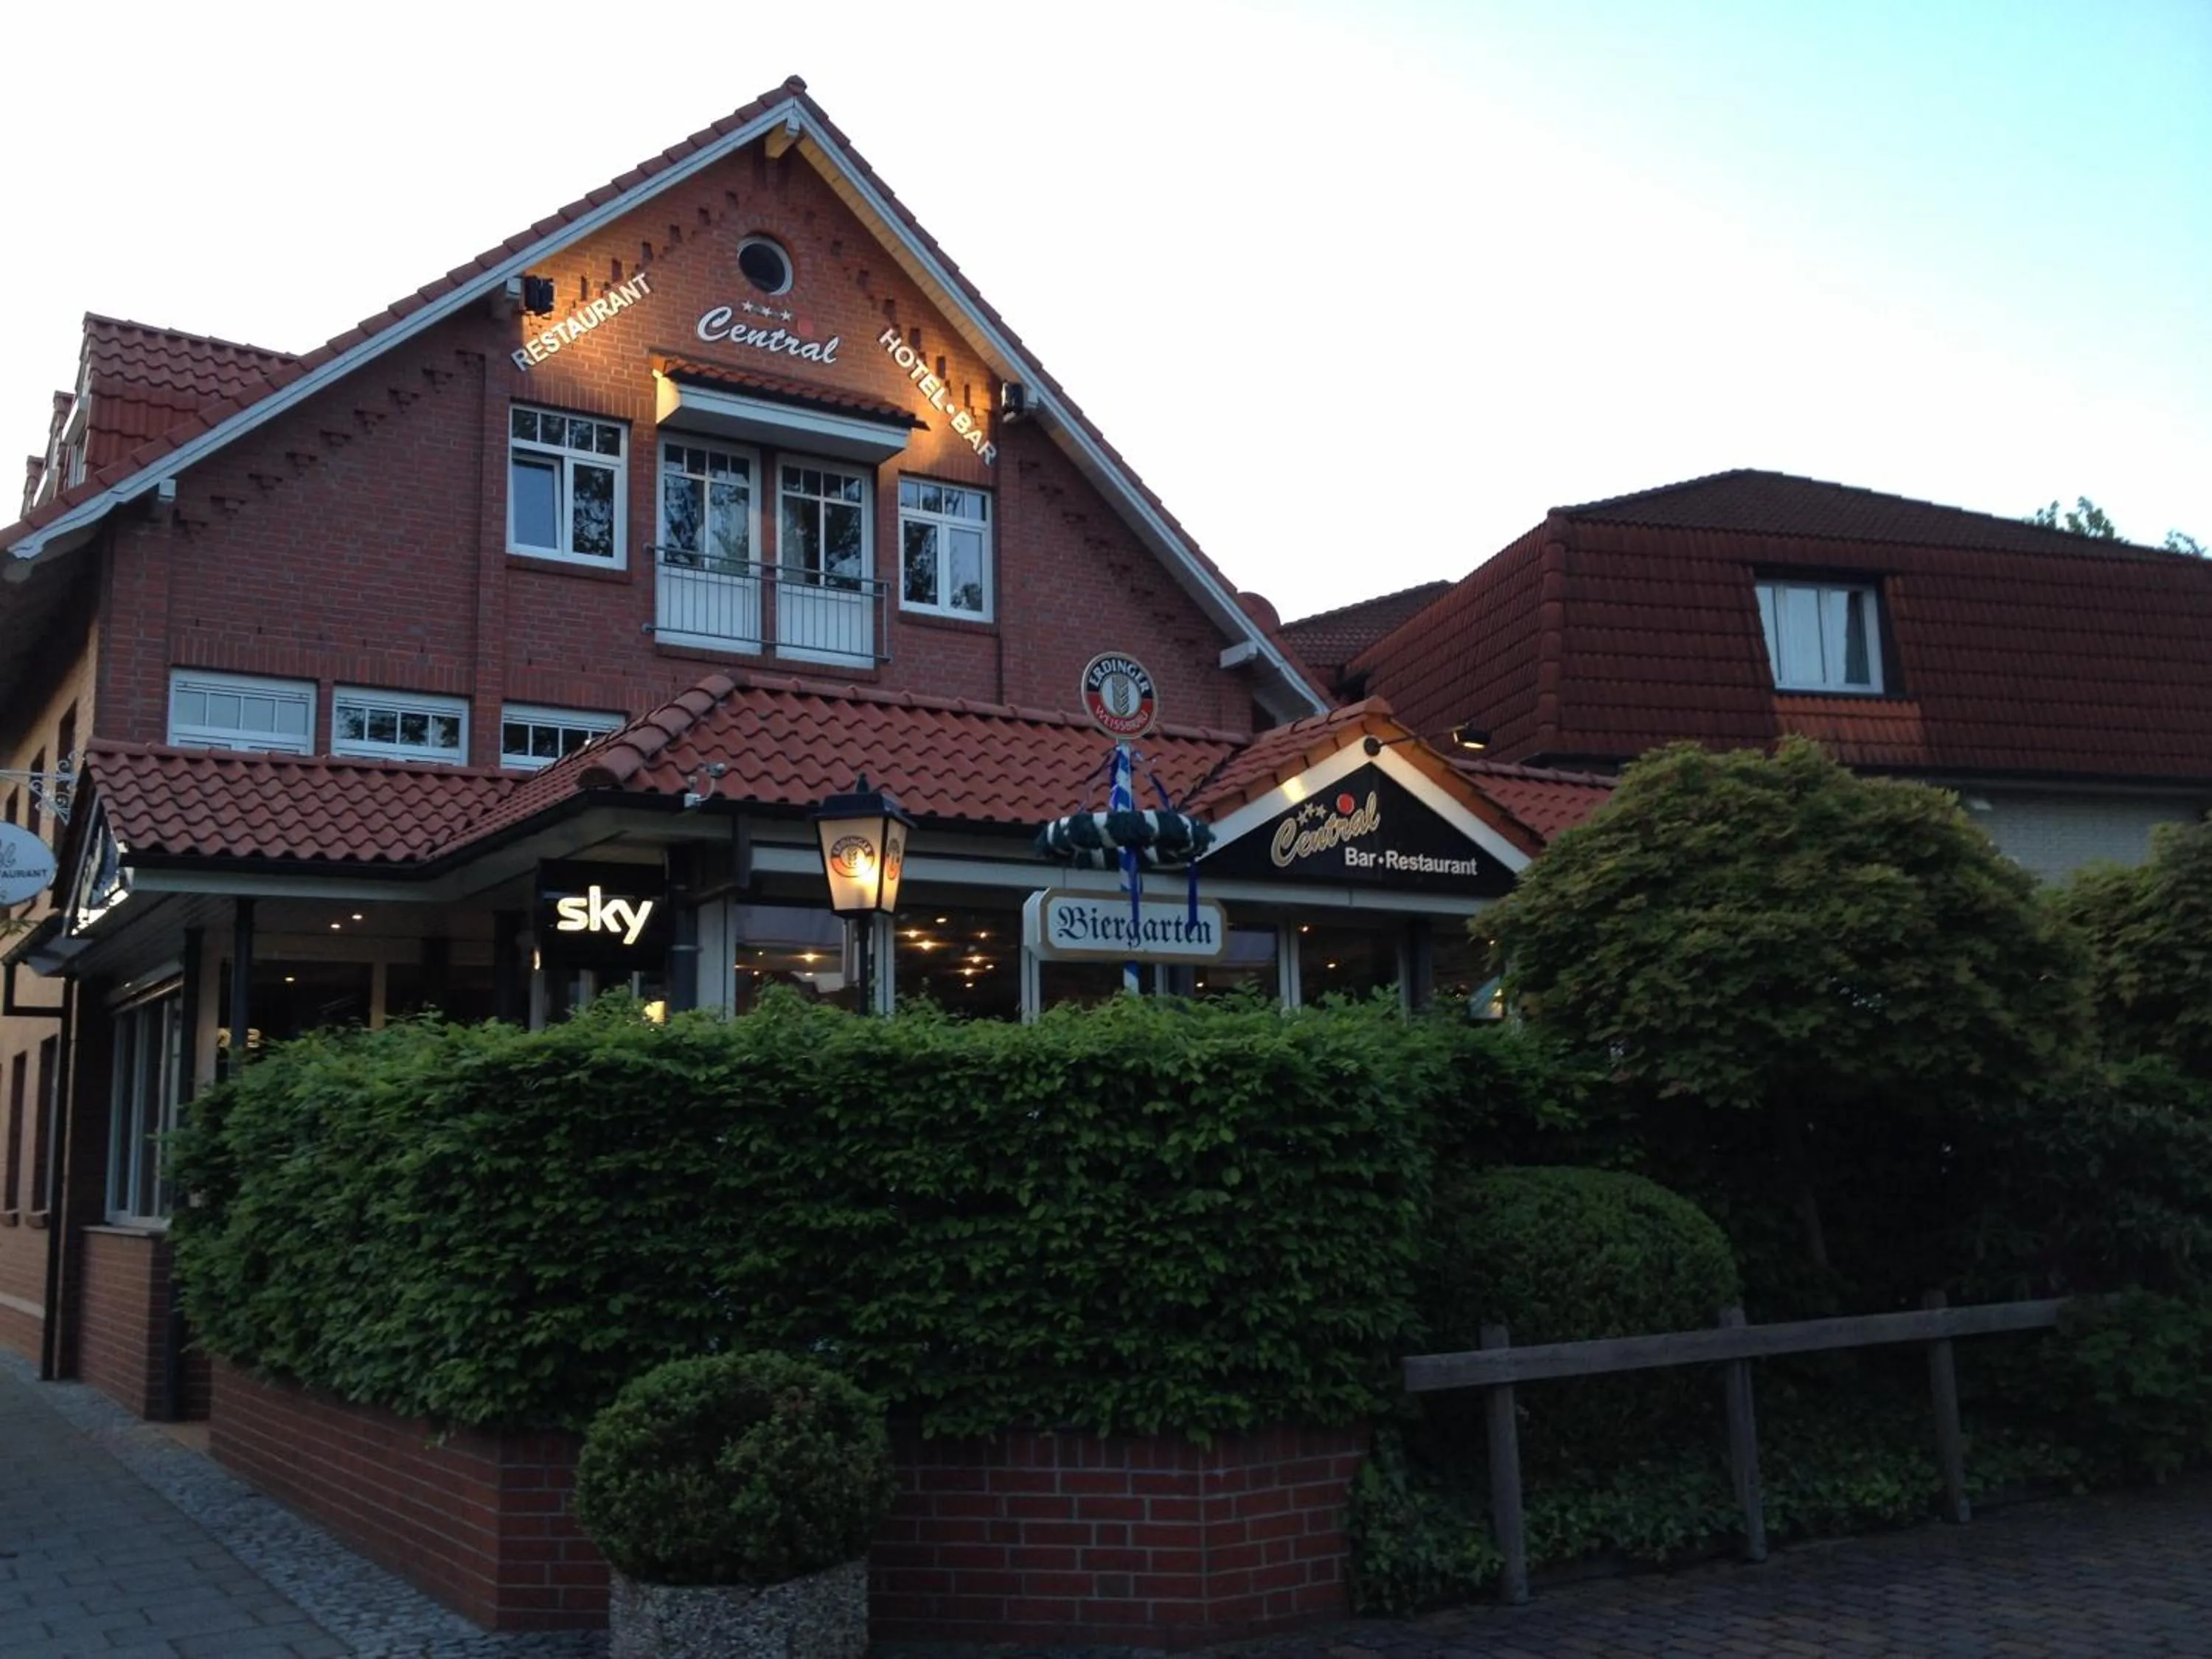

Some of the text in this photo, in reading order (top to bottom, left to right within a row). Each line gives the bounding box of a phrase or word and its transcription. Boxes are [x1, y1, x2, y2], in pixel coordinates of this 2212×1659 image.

[511, 272, 652, 372] RESTAURANT
[696, 305, 840, 364] Central
[879, 328, 997, 466] HOTEL BAR
[1089, 658, 1150, 692] ERDINGER
[1270, 790, 1380, 868] Central
[1385, 850, 1477, 875] Restaurant
[557, 886, 654, 945] sky
[1057, 905, 1212, 949] Biergarten
